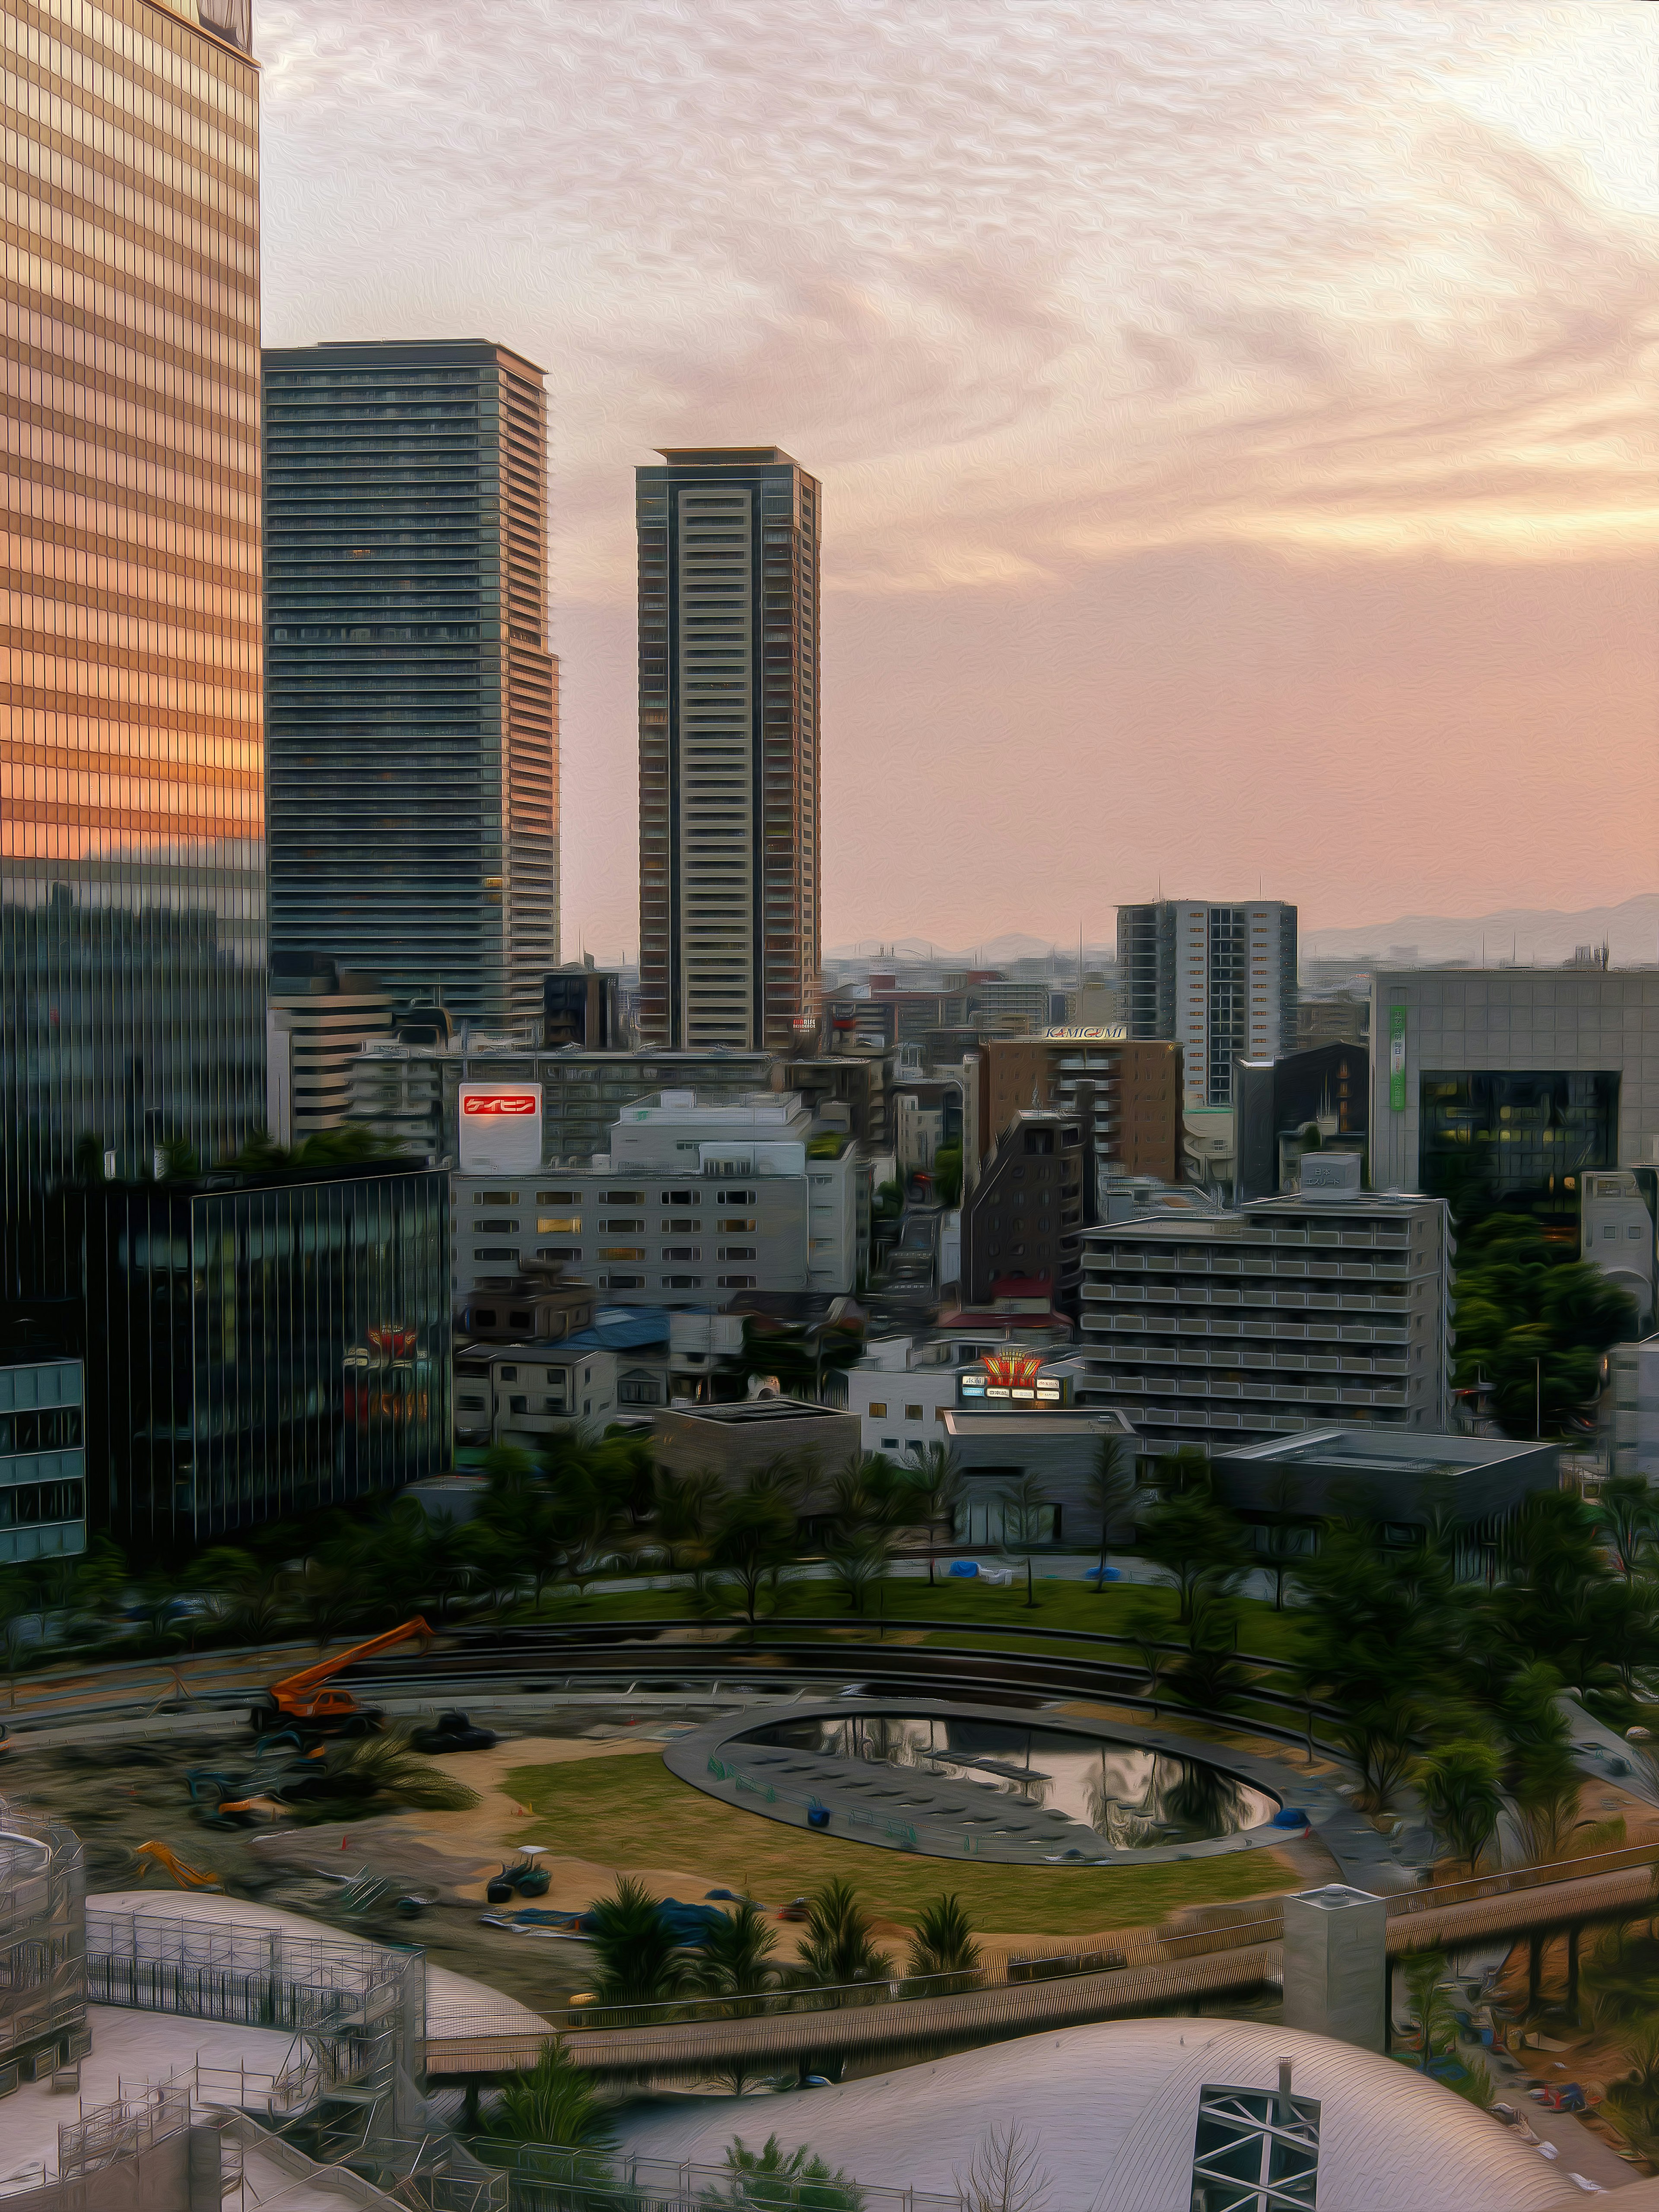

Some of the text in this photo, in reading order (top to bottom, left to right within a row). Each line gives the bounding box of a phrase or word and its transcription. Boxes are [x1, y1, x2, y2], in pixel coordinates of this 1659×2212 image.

[1045, 1028, 1123, 1038] KAMIGUMI
[466, 1098, 534, 1112] ケイヒン
